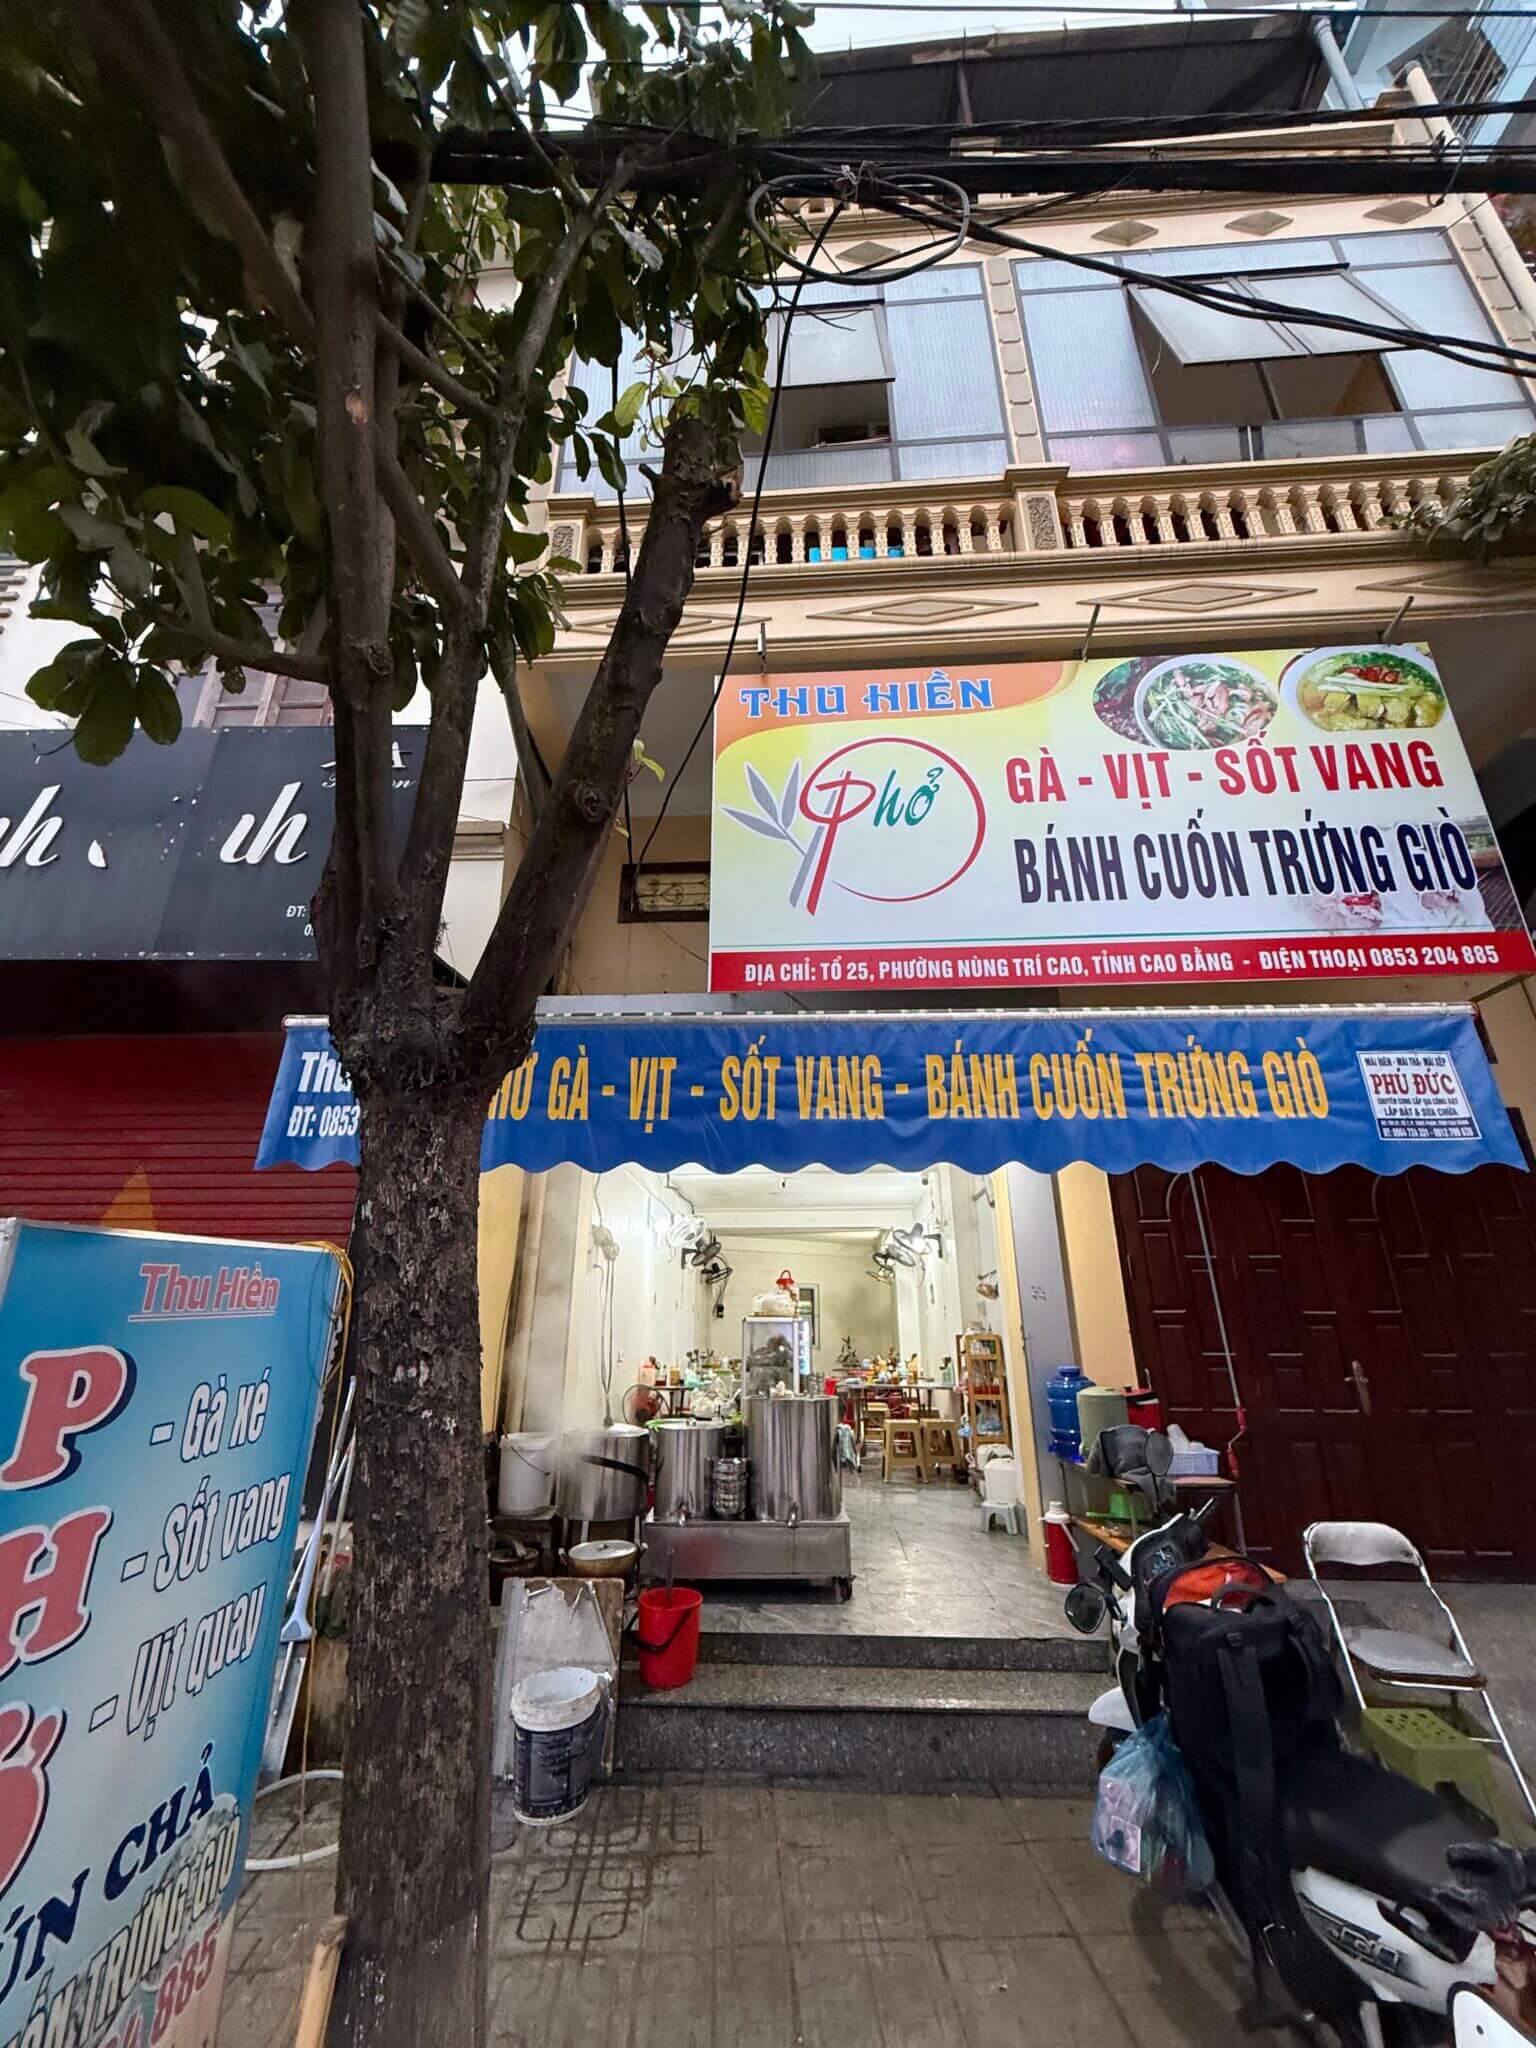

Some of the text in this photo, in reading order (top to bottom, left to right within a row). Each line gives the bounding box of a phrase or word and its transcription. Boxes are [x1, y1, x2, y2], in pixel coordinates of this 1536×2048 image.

[739, 671, 993, 718] THU HIỀN
[1005, 746, 1067, 804] GÀ
[1103, 751, 1172, 810] VỊT
[1216, 731, 1298, 795] SỐT
[1310, 740, 1444, 791] VANG
[1014, 806, 1478, 904] BÁNH CUỐN TRỨNG GIÒ
[744, 962, 775, 986] ĐỊA
[779, 957, 816, 982] CHỈ:
[820, 956, 842, 980] TỔ
[846, 961, 874, 983] 25,
[879, 956, 953, 981] PHƯỜNG
[957, 954, 1009, 978] NÙNG
[1012, 954, 1042, 977] TRÍ
[1046, 954, 1089, 977] CAO,
[1092, 949, 1136, 975] TỈNH
[1140, 952, 1177, 974] CAO
[1180, 946, 1233, 973] BẰNG
[1258, 946, 1305, 974] ĐIỆN
[1309, 947, 1366, 973] THOẠI
[1369, 947, 1419, 969] 0853
[1422, 945, 1459, 967] 204
[1463, 944, 1500, 965] 885
[547, 1044, 588, 1120] GÀ
[629, 1056, 677, 1134] VỊT
[719, 1034, 781, 1121] SỐT
[796, 1055, 885, 1121] VANG
[925, 1040, 1018, 1119] BÁNH
[1029, 1028, 1126, 1120] CUỐN
[1135, 1034, 1259, 1119] TRỨNG
[1262, 1037, 1329, 1119] GIÒ
[1370, 1068, 1455, 1095] PHÚ ĐỨC
[286, 1105, 361, 1137] ĐT: 0853
[139, 1262, 280, 1313] Thu Hiền
[180, 1374, 228, 1464] Gà
[228, 1367, 272, 1450] xé
[153, 1475, 219, 1593] Sốt
[221, 1472, 292, 1561] vang
